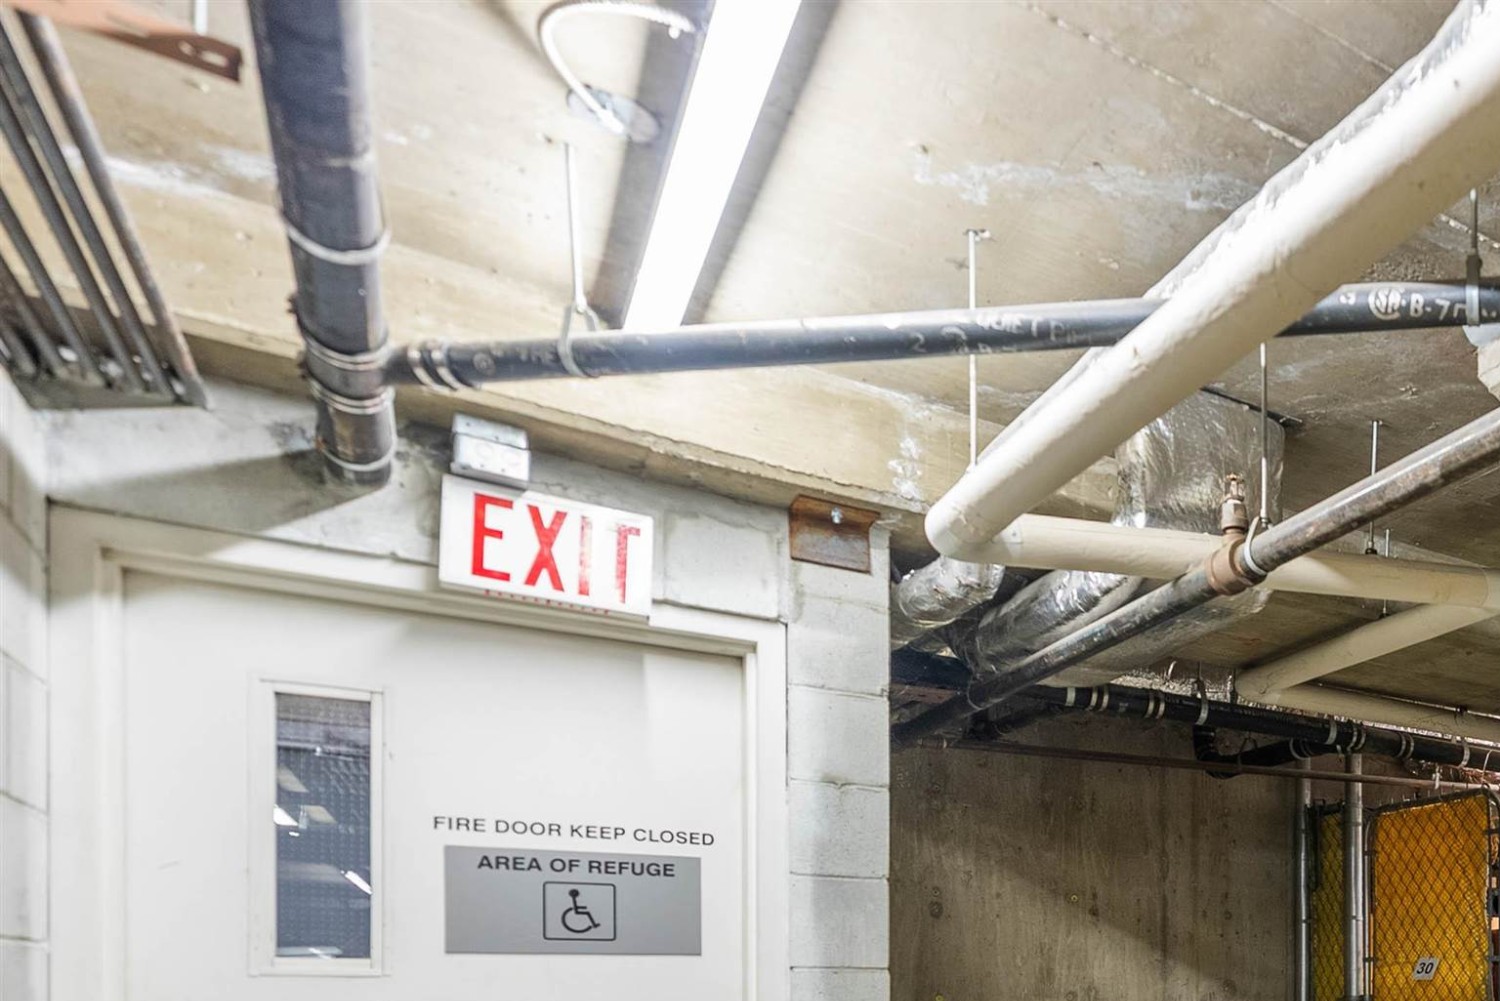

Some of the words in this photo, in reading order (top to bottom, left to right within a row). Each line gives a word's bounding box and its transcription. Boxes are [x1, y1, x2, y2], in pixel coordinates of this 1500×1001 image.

[471, 492, 641, 604] EXIT
[433, 816, 487, 833] FIRE
[495, 820, 562, 837] DOOR
[570, 824, 626, 841] KEEP
[633, 828, 715, 846] CLOSED
[477, 855, 542, 872] AREA
[549, 858, 581, 873] OF
[588, 860, 676, 877] REFUGE
[1416, 962, 1434, 974] 30
